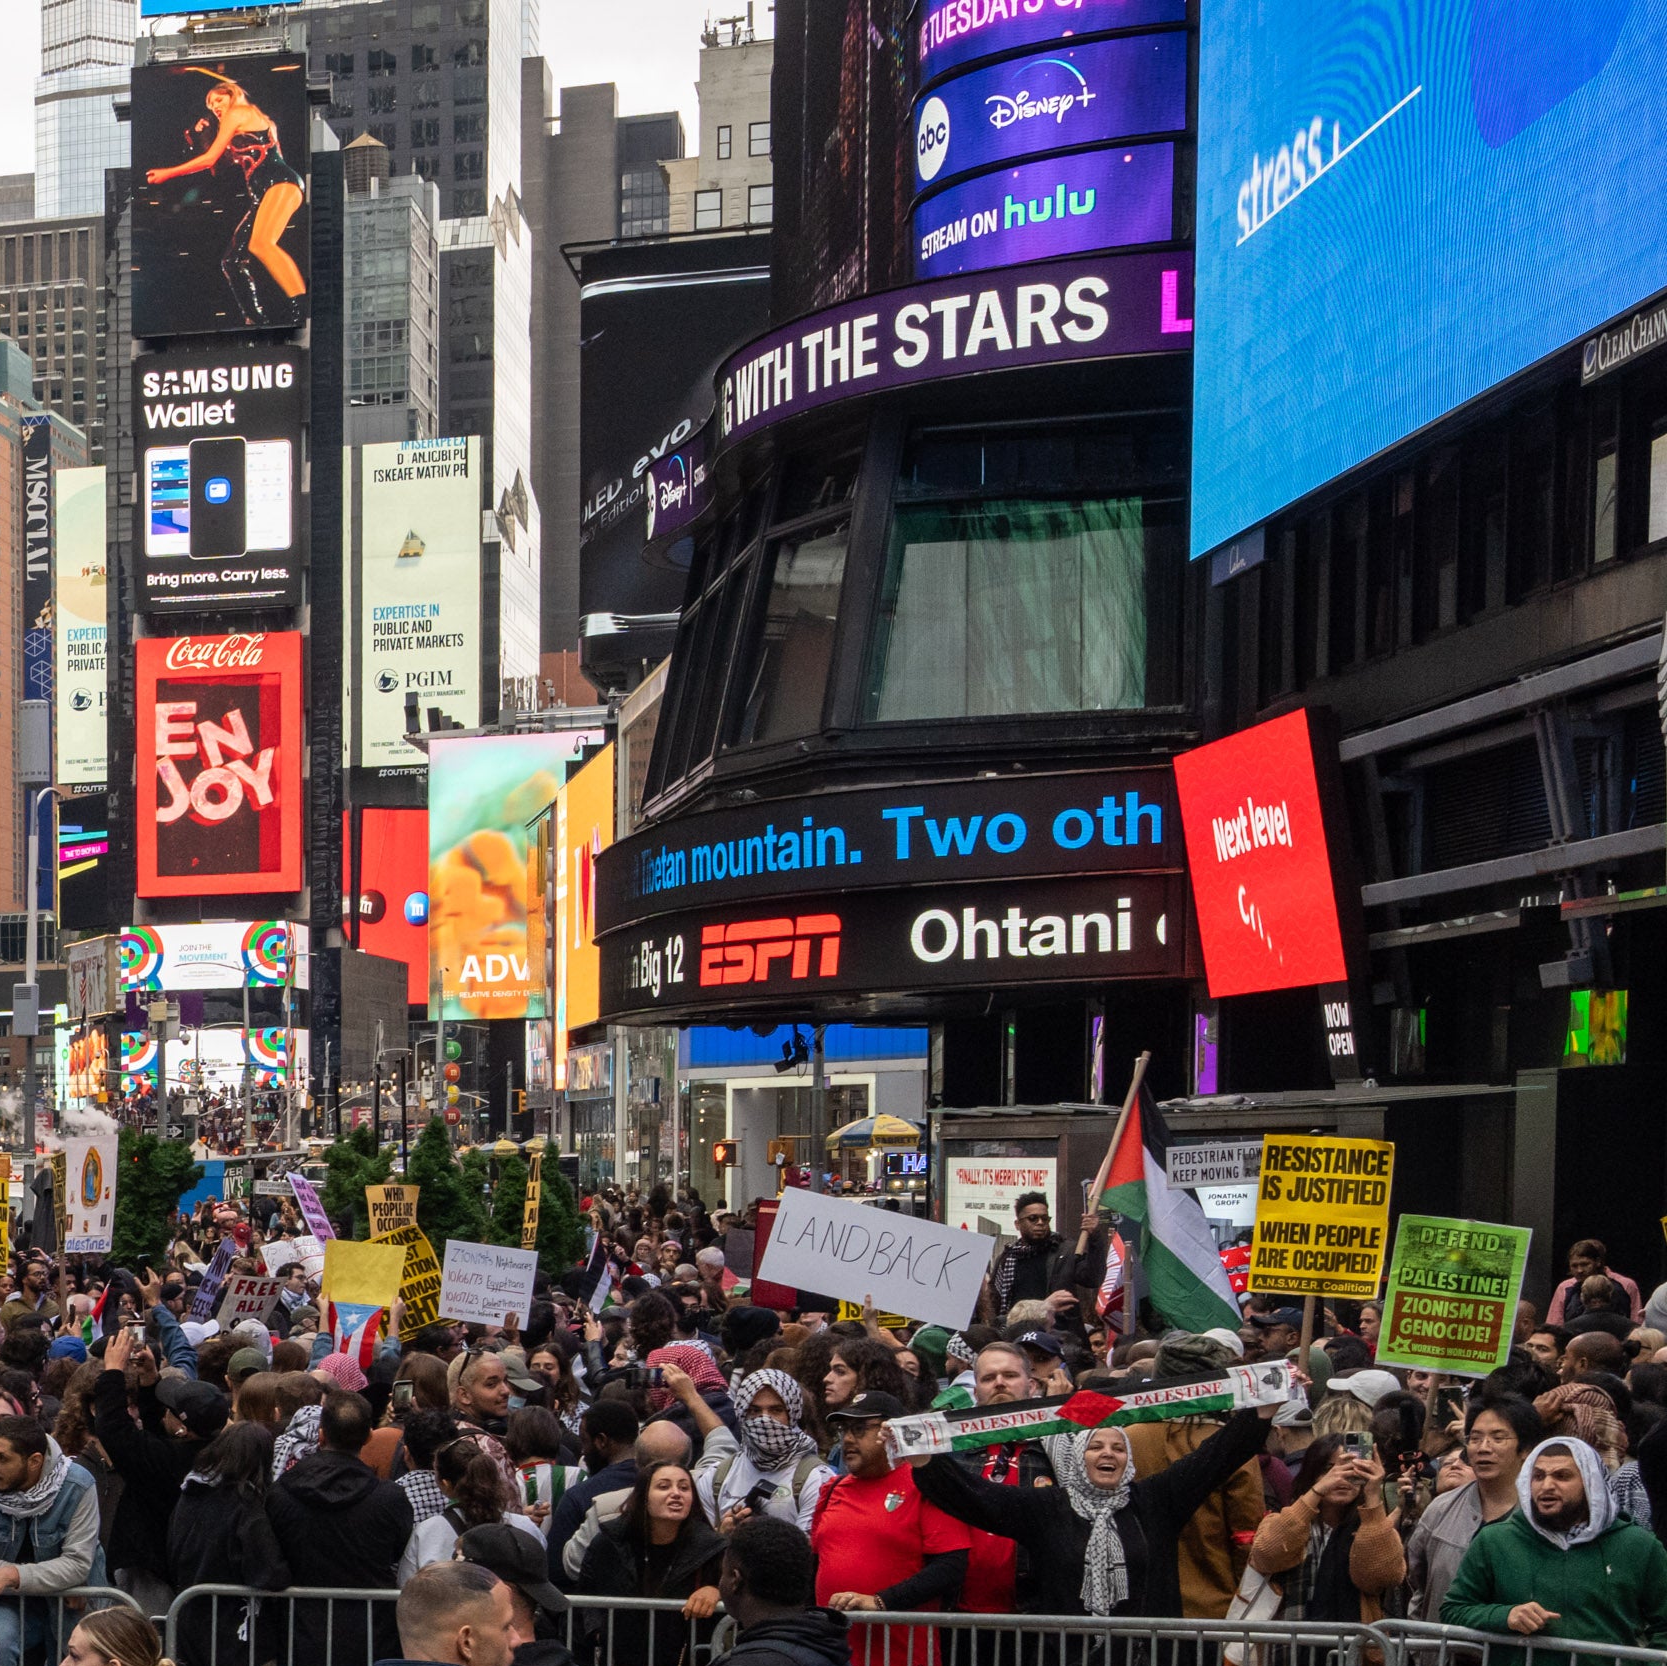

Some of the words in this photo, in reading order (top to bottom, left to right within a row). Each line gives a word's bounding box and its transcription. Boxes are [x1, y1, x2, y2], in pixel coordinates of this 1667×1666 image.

[919, 122, 947, 156] abc
[971, 208, 998, 238] ON
[1003, 184, 1095, 230] hulu
[736, 342, 795, 426] WITH
[801, 313, 879, 395] THE
[893, 276, 1111, 369] STARS
[143, 364, 293, 398] SAMSUNG
[144, 400, 235, 429] Wallet
[147, 573, 179, 588] Bring
[181, 572, 219, 584] more.
[221, 569, 259, 584] Carry
[261, 566, 289, 580] less.
[373, 604, 427, 621] EXPERTISE
[429, 604, 440, 617] IN
[373, 620, 409, 636] PUBLIC
[411, 619, 432, 634] AND
[67, 642, 101, 656] PUBLIC
[373, 636, 415, 652] PRIVATE
[416, 634, 464, 648] MARKETS
[67, 658, 106, 672] PRIVATE
[405, 670, 453, 688] PGIM
[1214, 813, 1250, 864] Next
[1251, 796, 1293, 848] level
[689, 816, 862, 886] mountain.
[882, 805, 1027, 862] Two
[665, 933, 685, 986] 12
[699, 912, 842, 988] ESPN
[909, 898, 1131, 965] Ohtani
[179, 952, 228, 962] MOVEMENT
[1324, 1002, 1350, 1030] NOW
[1329, 1030, 1355, 1057] OPEN
[1172, 1150, 1234, 1166] PEDESTRIAN
[1265, 1144, 1391, 1176] RESISTANCE
[1172, 1169, 1197, 1183] KEEP
[1201, 1166, 1239, 1182] MOVING
[1208, 1192, 1248, 1200] JONATHAN
[1261, 1175, 1281, 1201] IS
[1286, 1176, 1387, 1206] JUSTIFIED
[1259, 1220, 1311, 1246] WHEN
[1315, 1224, 1381, 1250] PEOPLE
[1420, 1226, 1501, 1252] DEFEND
[777, 1211, 971, 1292] LANDBACK
[1255, 1248, 1287, 1270] ARE
[1292, 1250, 1377, 1274] OCCUPIED!
[234, 1279, 281, 1297] FREE
[1255, 1278, 1321, 1290] A.N.S.W.E.R.
[1322, 1280, 1373, 1294] Coalition
[1400, 1267, 1509, 1298] PALESTINE!
[235, 1300, 265, 1313] ALL
[1402, 1296, 1473, 1320] ZIONISM
[1477, 1304, 1495, 1322] IS
[1399, 1318, 1491, 1344] GENOCIDE!
[1411, 1344, 1446, 1356] WORKERS
[1447, 1346, 1471, 1359] WORLD
[1471, 1348, 1497, 1362] PARTY
[1134, 1381, 1223, 1406] PALESTINE
[961, 1410, 1047, 1434] PALESTINE
